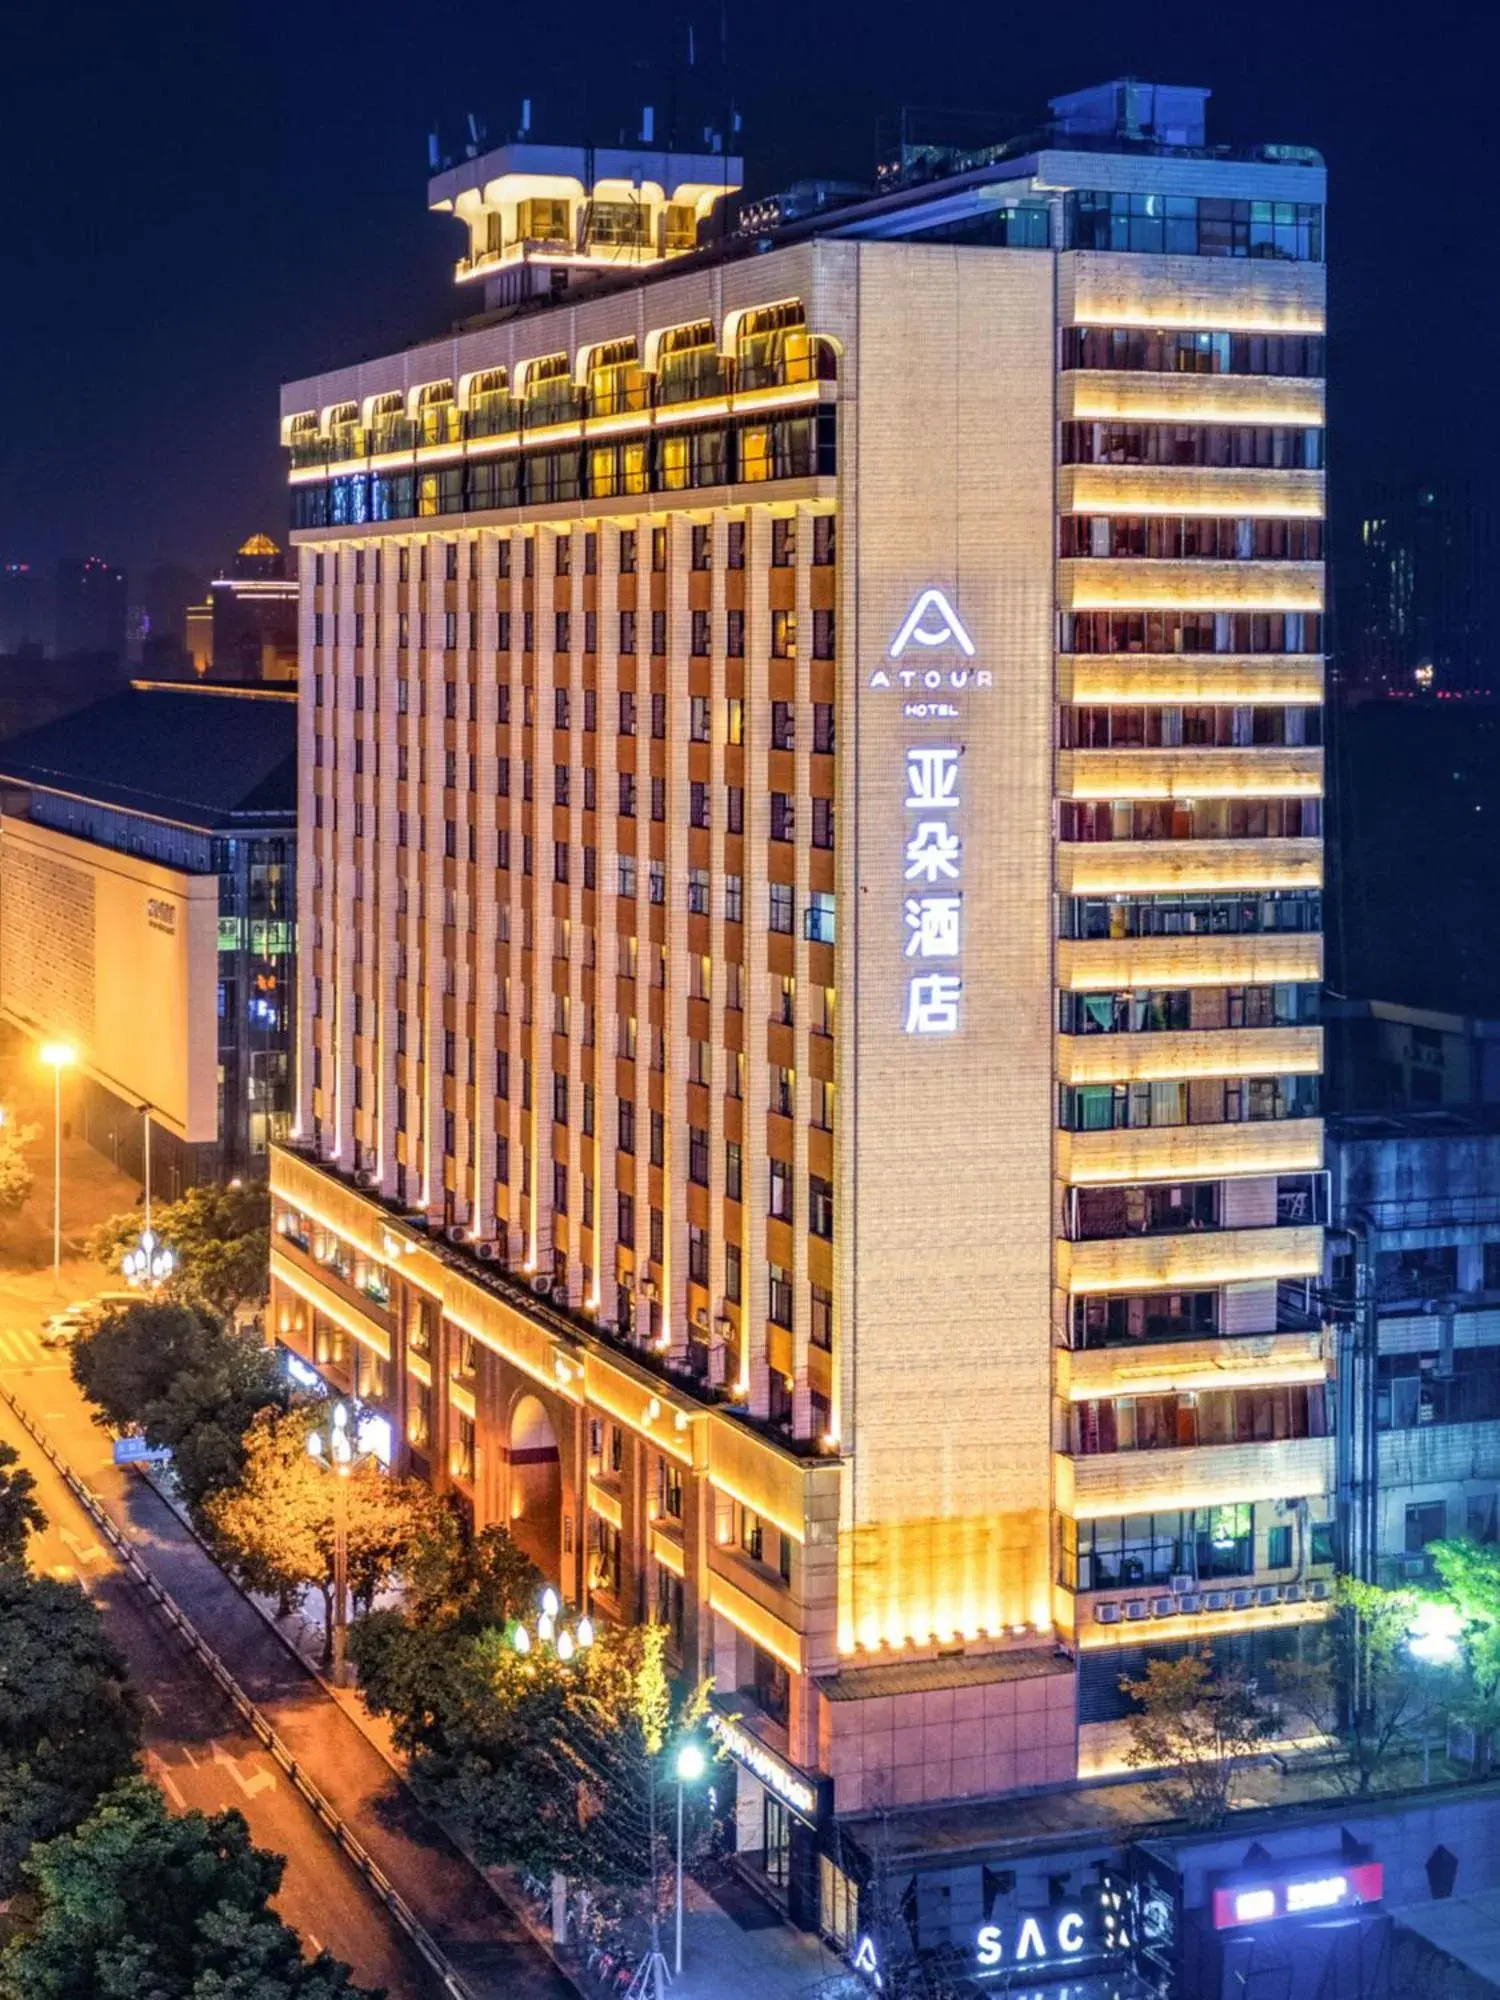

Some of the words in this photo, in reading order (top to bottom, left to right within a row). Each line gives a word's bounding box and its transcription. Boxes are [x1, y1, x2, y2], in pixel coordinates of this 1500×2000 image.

[870, 670, 993, 688] ATOUR
[905, 703, 959, 717] HOTEL
[905, 748, 960, 1034] 亚朵酒店
